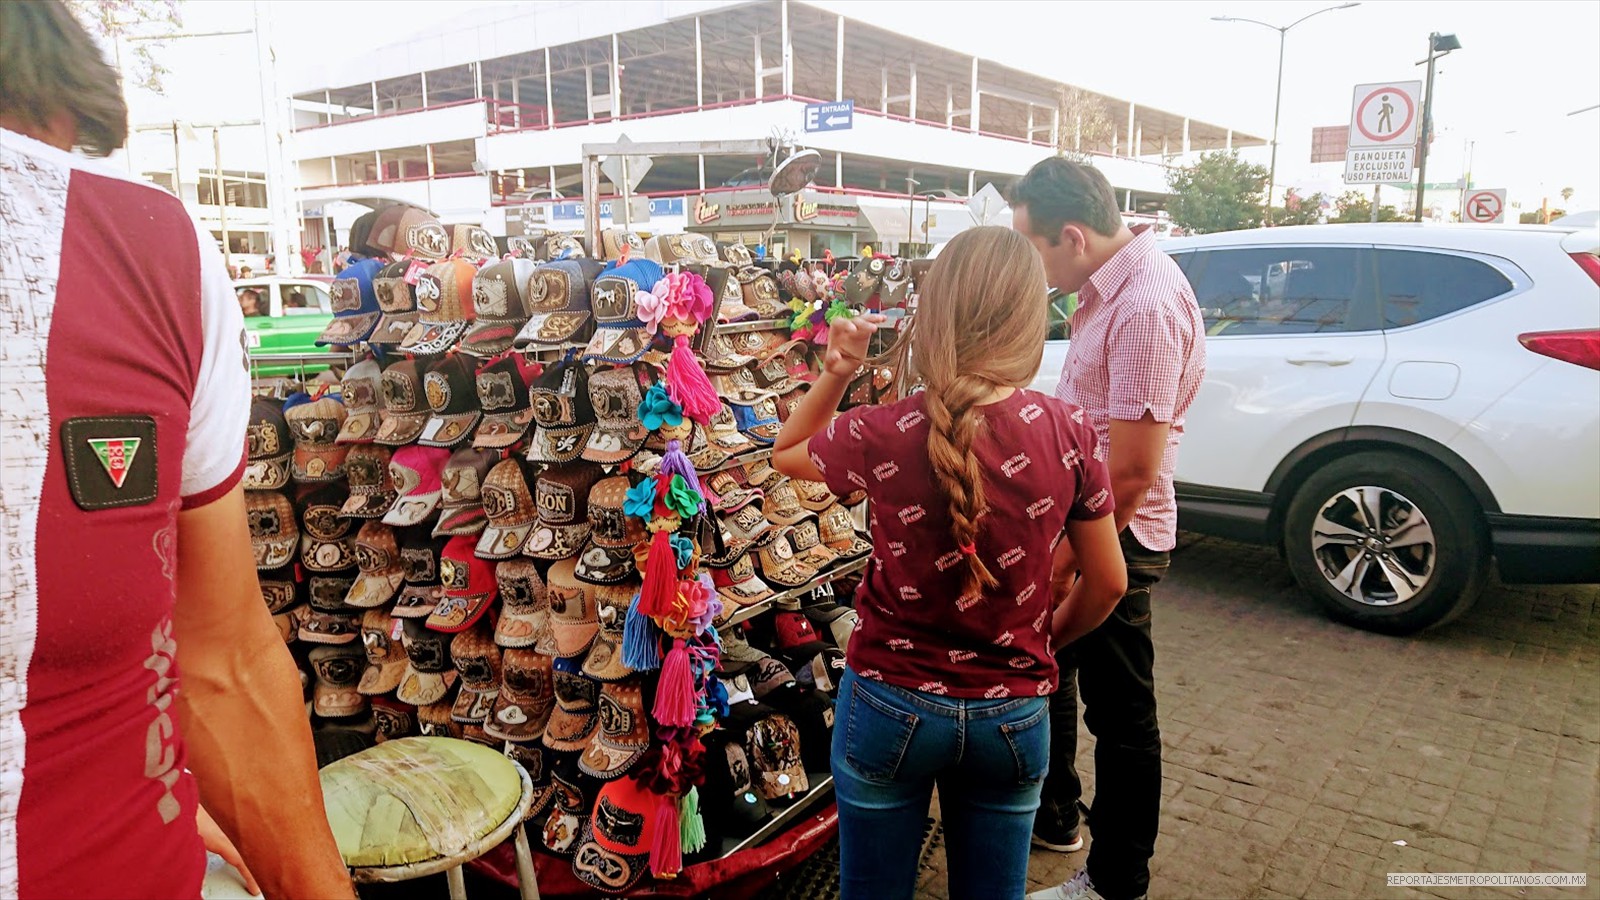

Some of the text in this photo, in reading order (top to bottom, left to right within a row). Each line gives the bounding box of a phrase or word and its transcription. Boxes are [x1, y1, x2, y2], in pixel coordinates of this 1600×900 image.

[821, 103, 850, 114] ENTRADA
[806, 107, 820, 130] E
[1354, 151, 1406, 161] BANQUETA
[1353, 161, 1405, 171] EXCLUSIVO
[1347, 171, 1408, 181] USO PEATONAL
